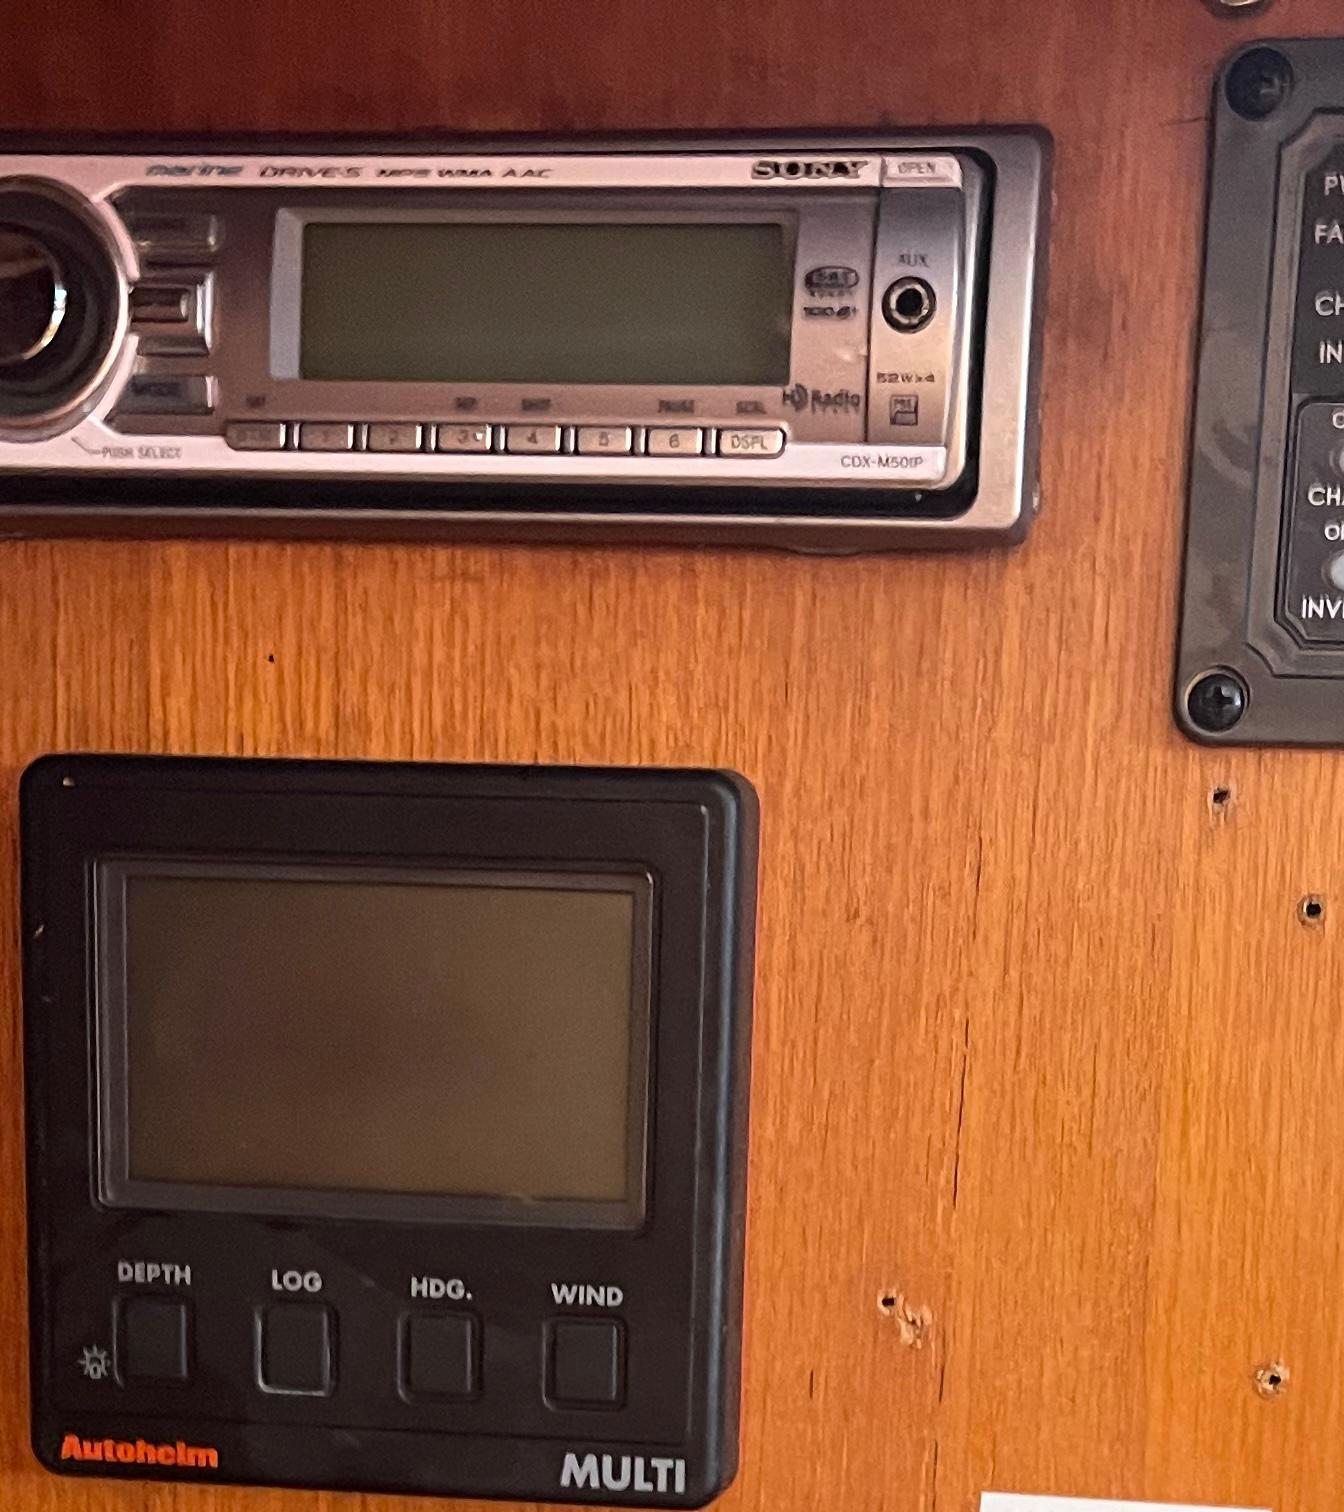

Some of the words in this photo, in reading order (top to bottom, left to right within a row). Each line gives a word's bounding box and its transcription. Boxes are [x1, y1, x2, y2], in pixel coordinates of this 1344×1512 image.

[501, 167, 554, 179] AAC
[751, 158, 869, 180] SONY
[117, 1260, 192, 1287] DEPTH
[271, 1269, 323, 1294] LOG
[410, 1276, 473, 1301] HDG.
[551, 1283, 624, 1308] WIND
[559, 1452, 688, 1494] MULTI
